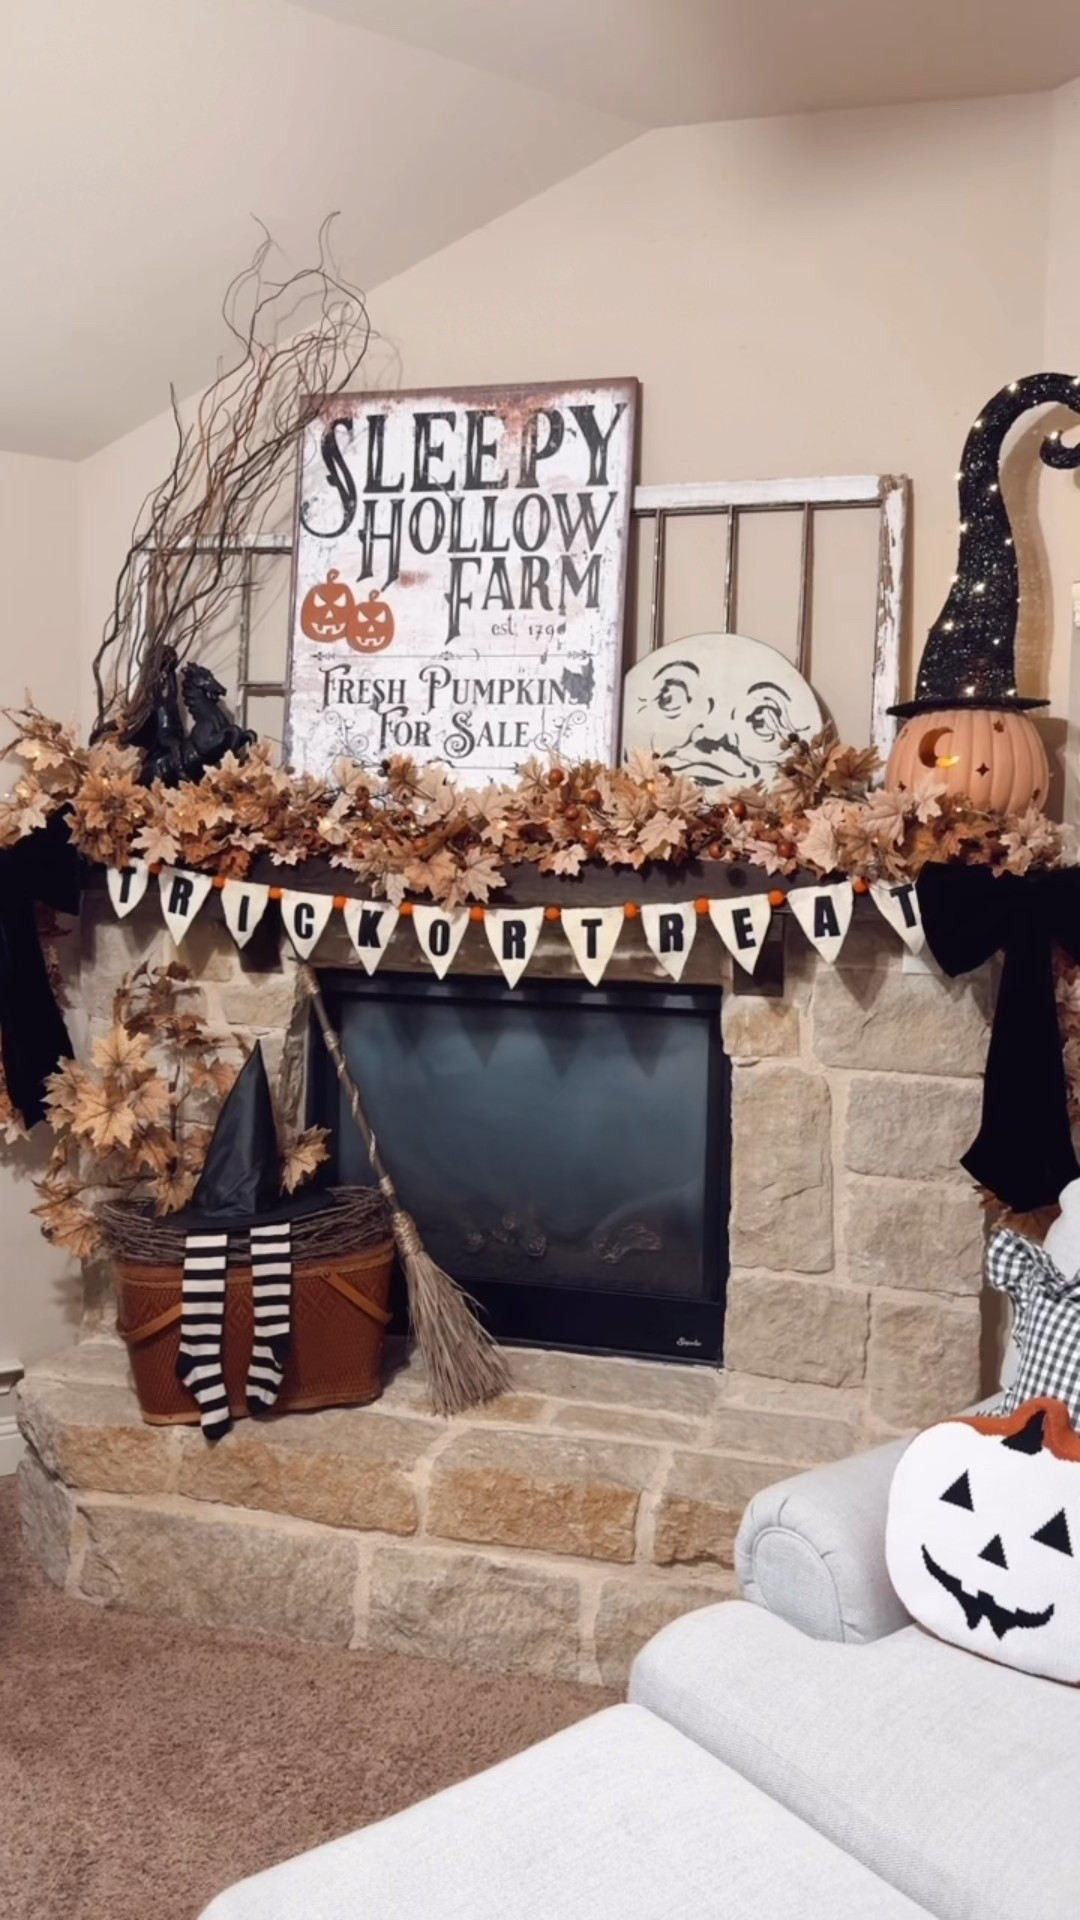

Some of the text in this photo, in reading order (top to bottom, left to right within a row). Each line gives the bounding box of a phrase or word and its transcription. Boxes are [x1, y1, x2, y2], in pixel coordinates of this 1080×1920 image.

[300, 403, 628, 538] SLEEPY
[356, 491, 618, 592] HOLLOW
[444, 553, 603, 645] FARM
[316, 663, 407, 713] FRESH
[373, 705, 531, 759] FOR SALE
[119, 866, 918, 960] TRICK OR TREAT
